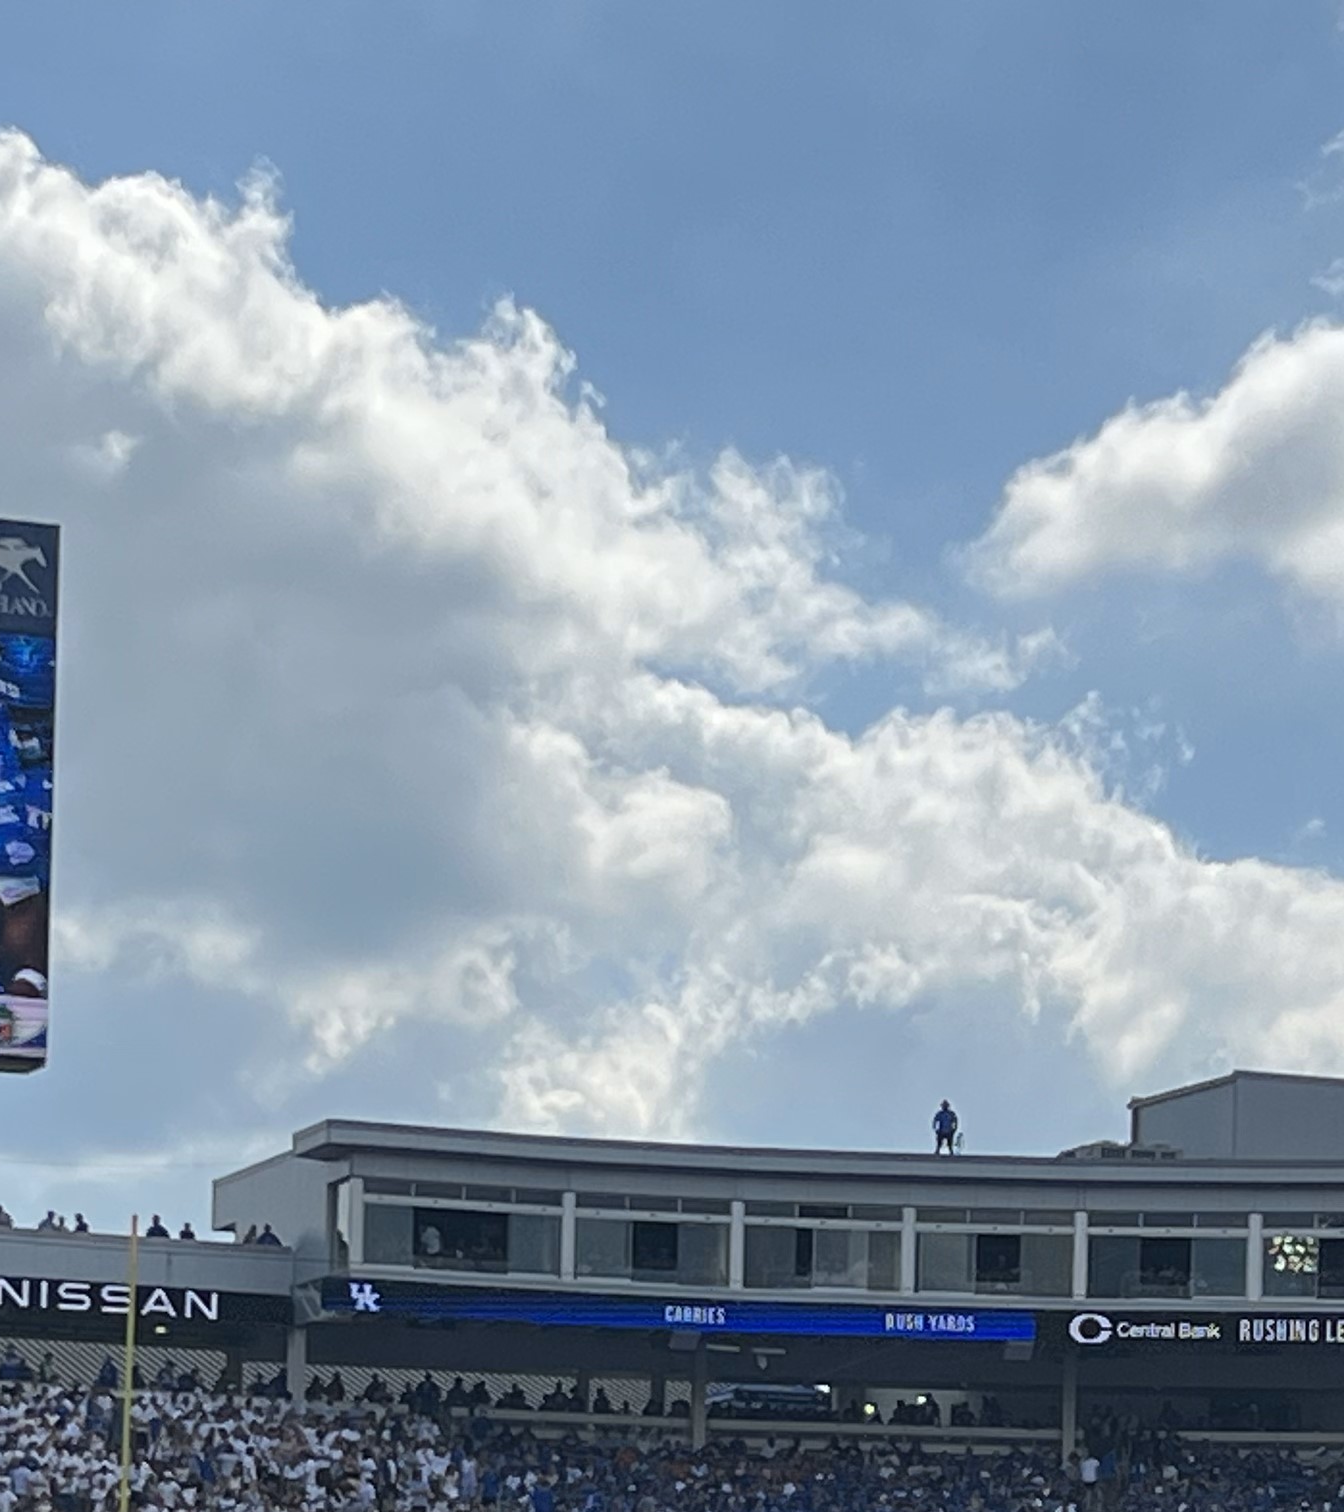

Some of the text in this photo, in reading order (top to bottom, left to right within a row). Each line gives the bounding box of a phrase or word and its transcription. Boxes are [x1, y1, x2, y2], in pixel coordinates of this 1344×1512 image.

[1116, 1322, 1221, 1339] Central Bank
[1239, 1319, 1320, 1342] RUSHING
